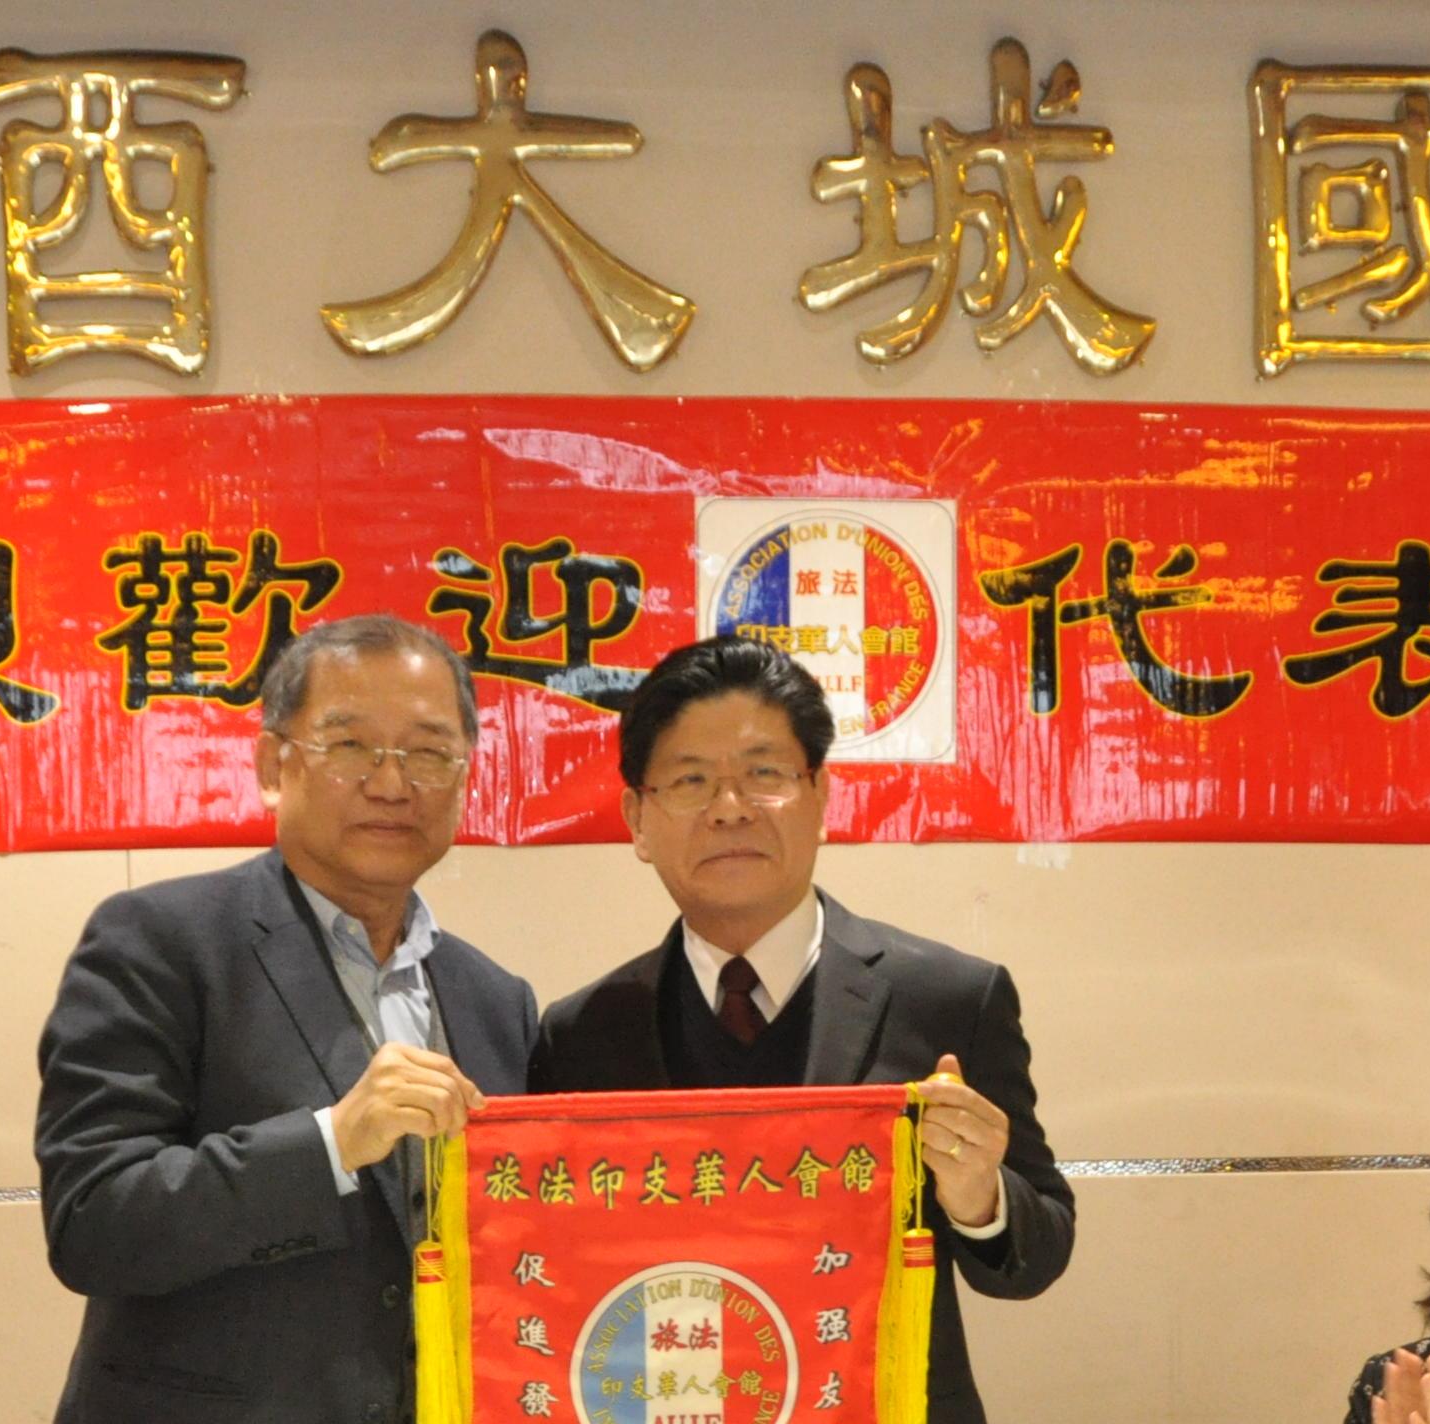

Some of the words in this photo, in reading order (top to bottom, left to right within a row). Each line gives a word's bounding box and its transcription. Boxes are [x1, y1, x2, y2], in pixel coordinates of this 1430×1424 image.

[723, 522, 828, 619] ASSOCIATION
[837, 523, 911, 582] D'UNION
[903, 579, 929, 621] DES
[795, 569, 859, 596] 旅法
[839, 714, 866, 736] EN
[868, 659, 926, 723] FRANCE
[485, 1143, 879, 1210] 旅法印支華人會館
[586, 1278, 682, 1374] ASSOCIATION
[689, 1277, 761, 1325] D'UNION
[754, 1325, 781, 1363] DES
[650, 1316, 719, 1352] 旅法
[600, 1369, 764, 1401] 印支華人會館
